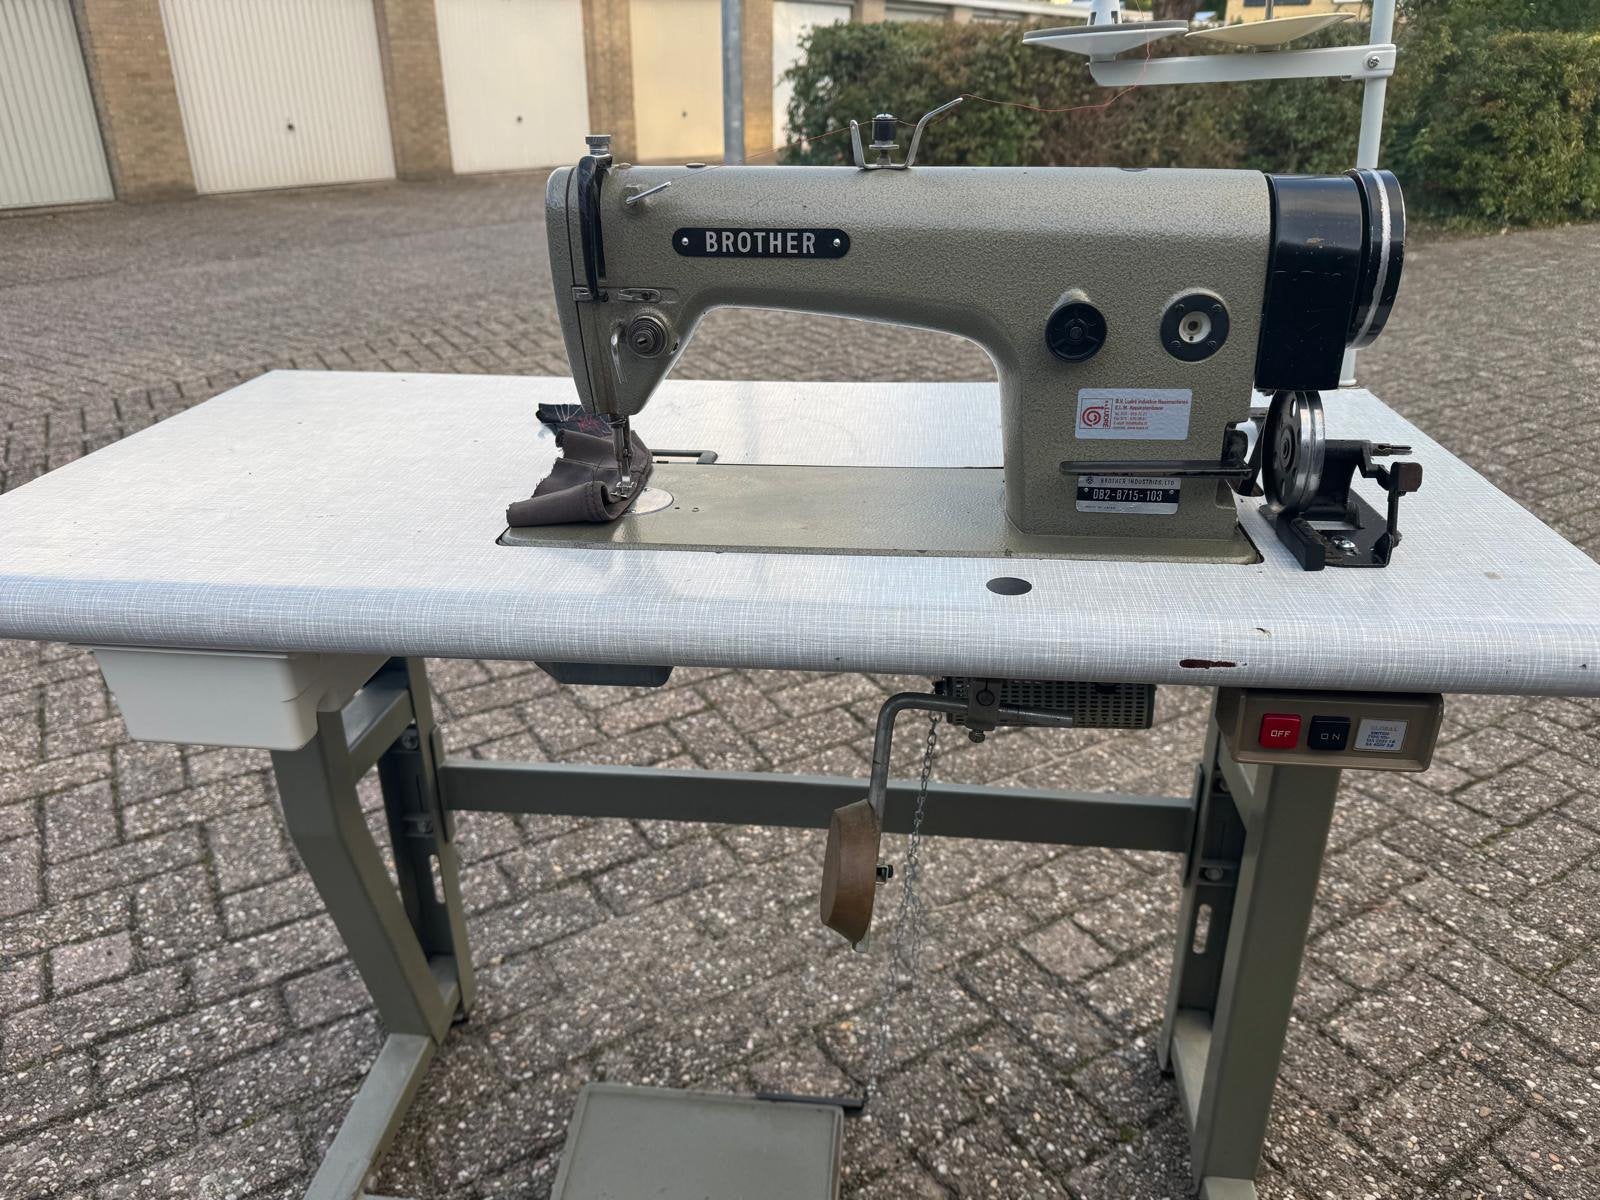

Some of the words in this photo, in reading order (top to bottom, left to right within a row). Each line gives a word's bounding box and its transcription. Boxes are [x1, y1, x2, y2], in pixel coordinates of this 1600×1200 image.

[705, 231, 816, 254] BROTHER
[1270, 729, 1292, 738] OFF
[1320, 733, 1341, 741] ON
